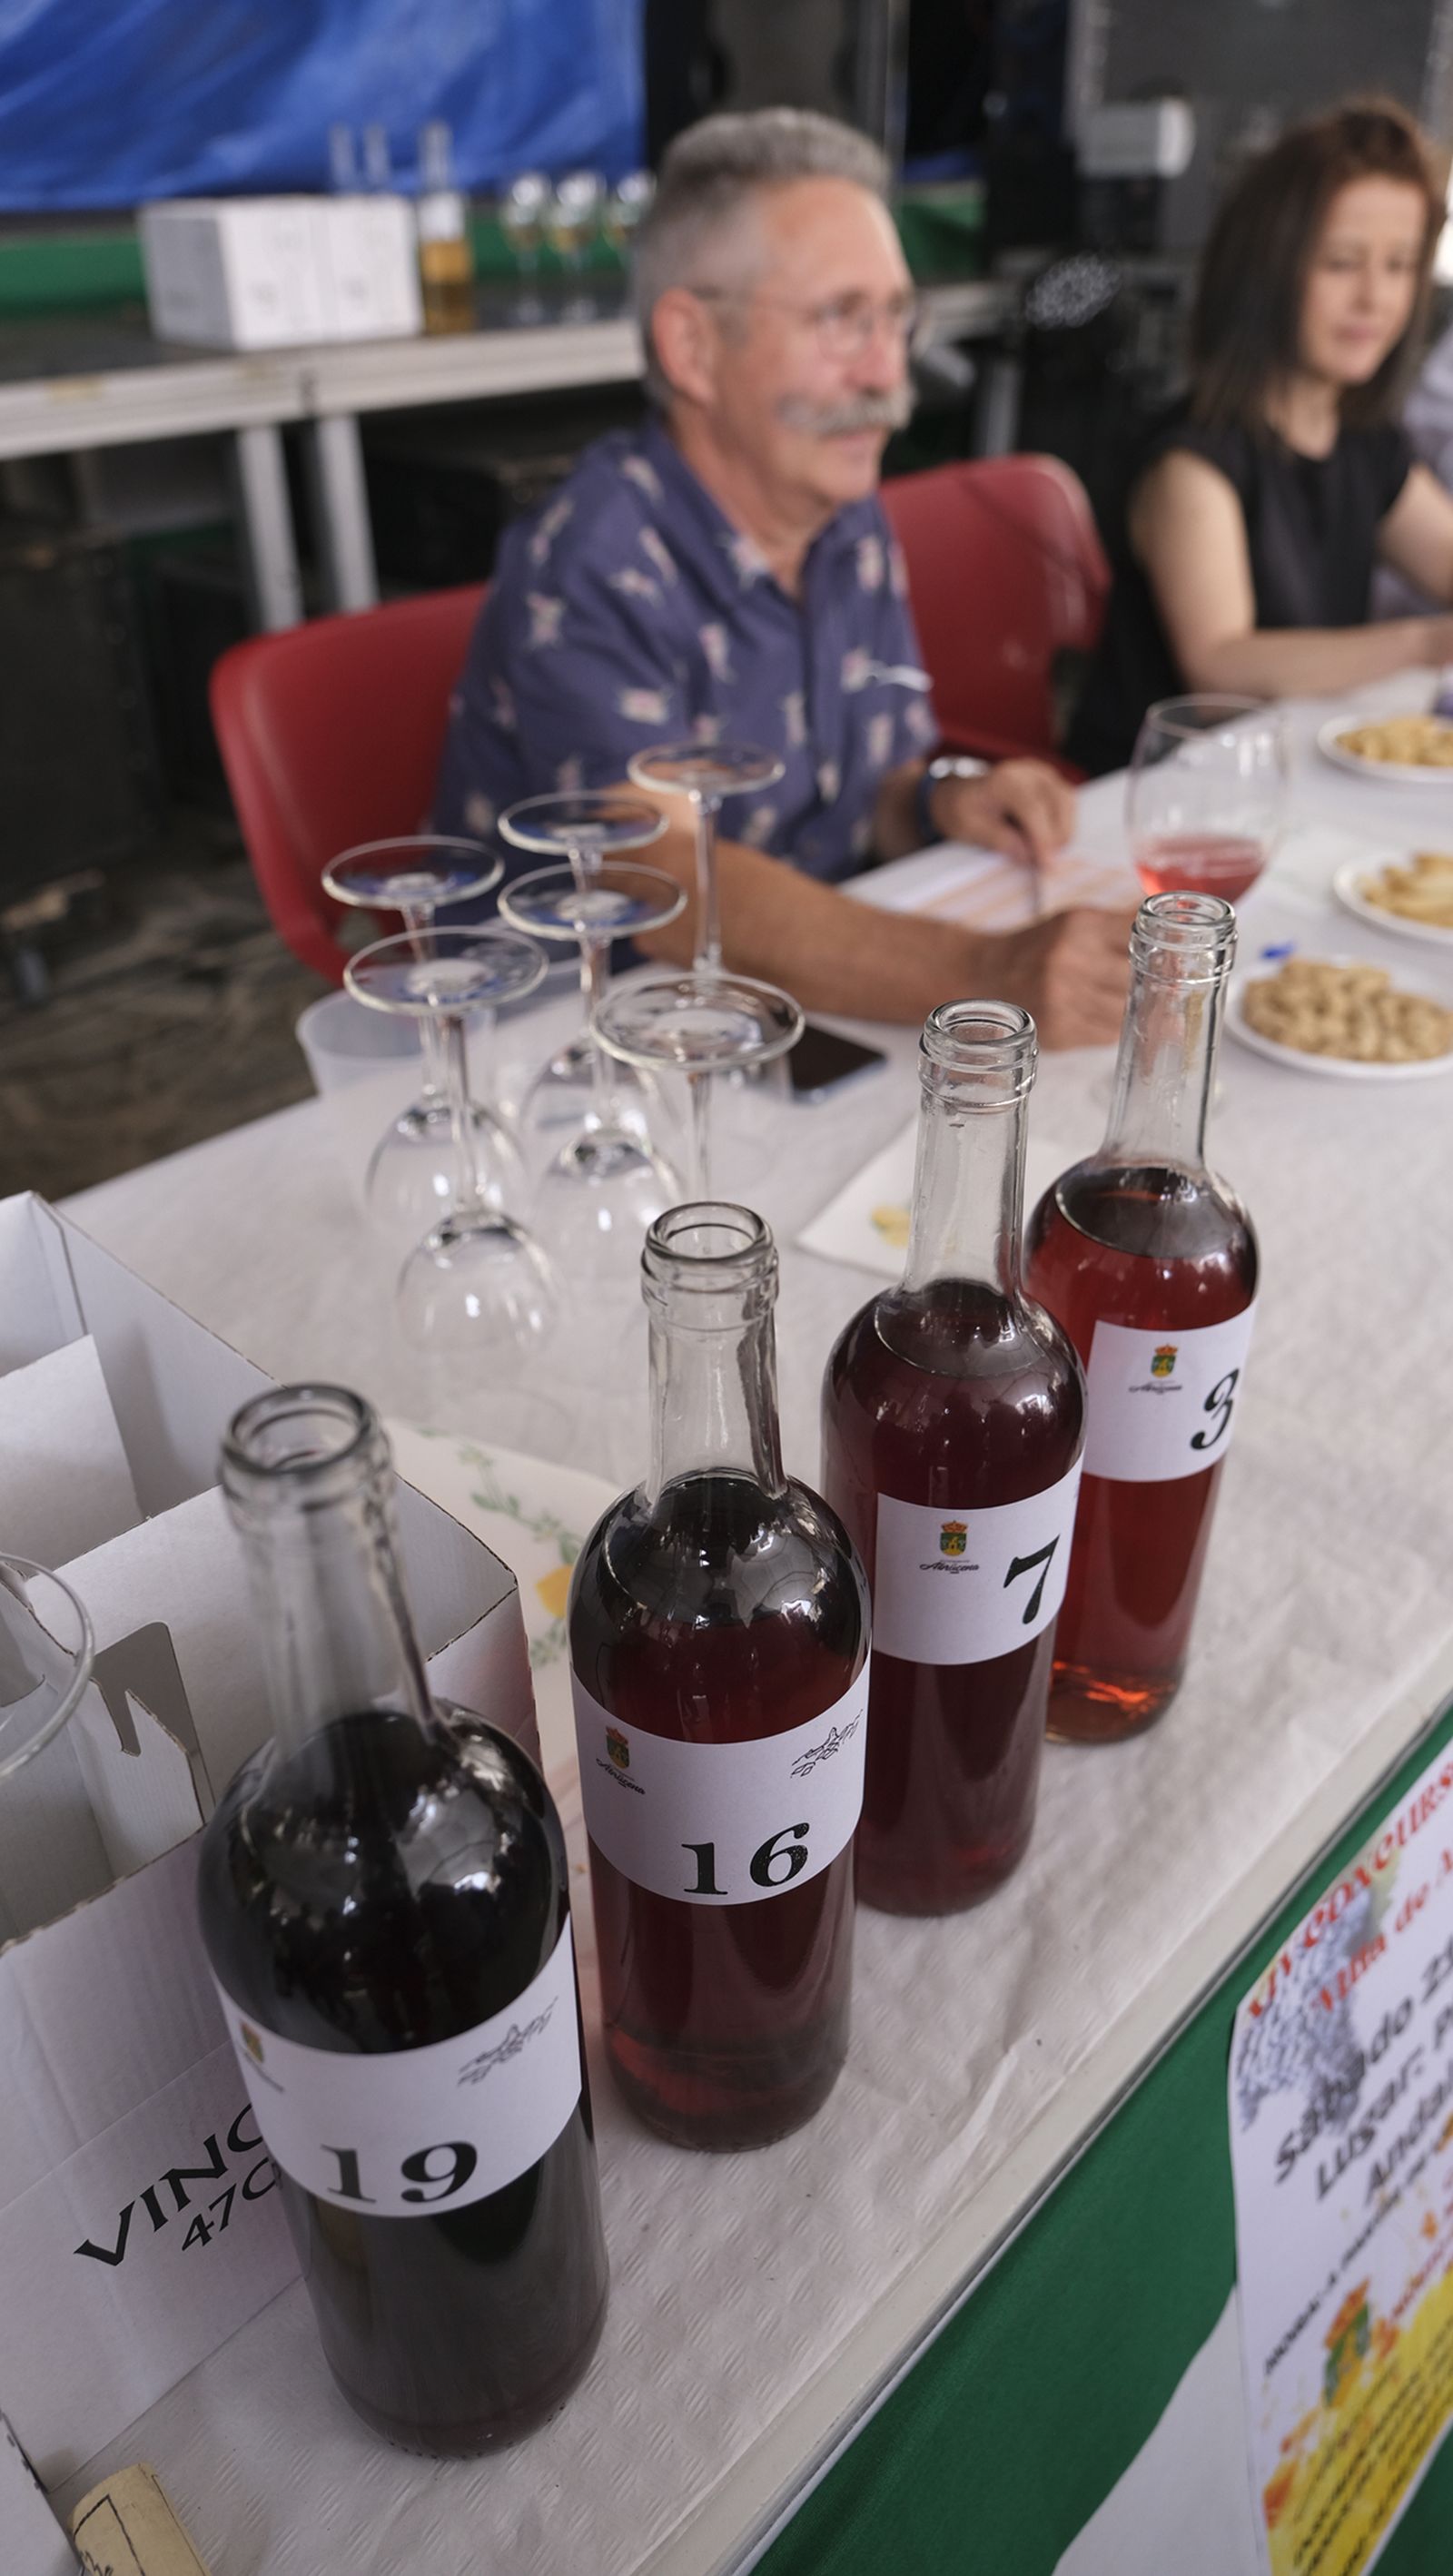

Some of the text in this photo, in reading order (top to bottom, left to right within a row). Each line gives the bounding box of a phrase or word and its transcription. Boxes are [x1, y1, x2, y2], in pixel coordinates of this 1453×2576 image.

[1191, 1367, 1240, 1451] 3
[1003, 1533, 1061, 1625] 7
[681, 1821, 810, 1895] 16
[321, 2140, 479, 2204] 19
